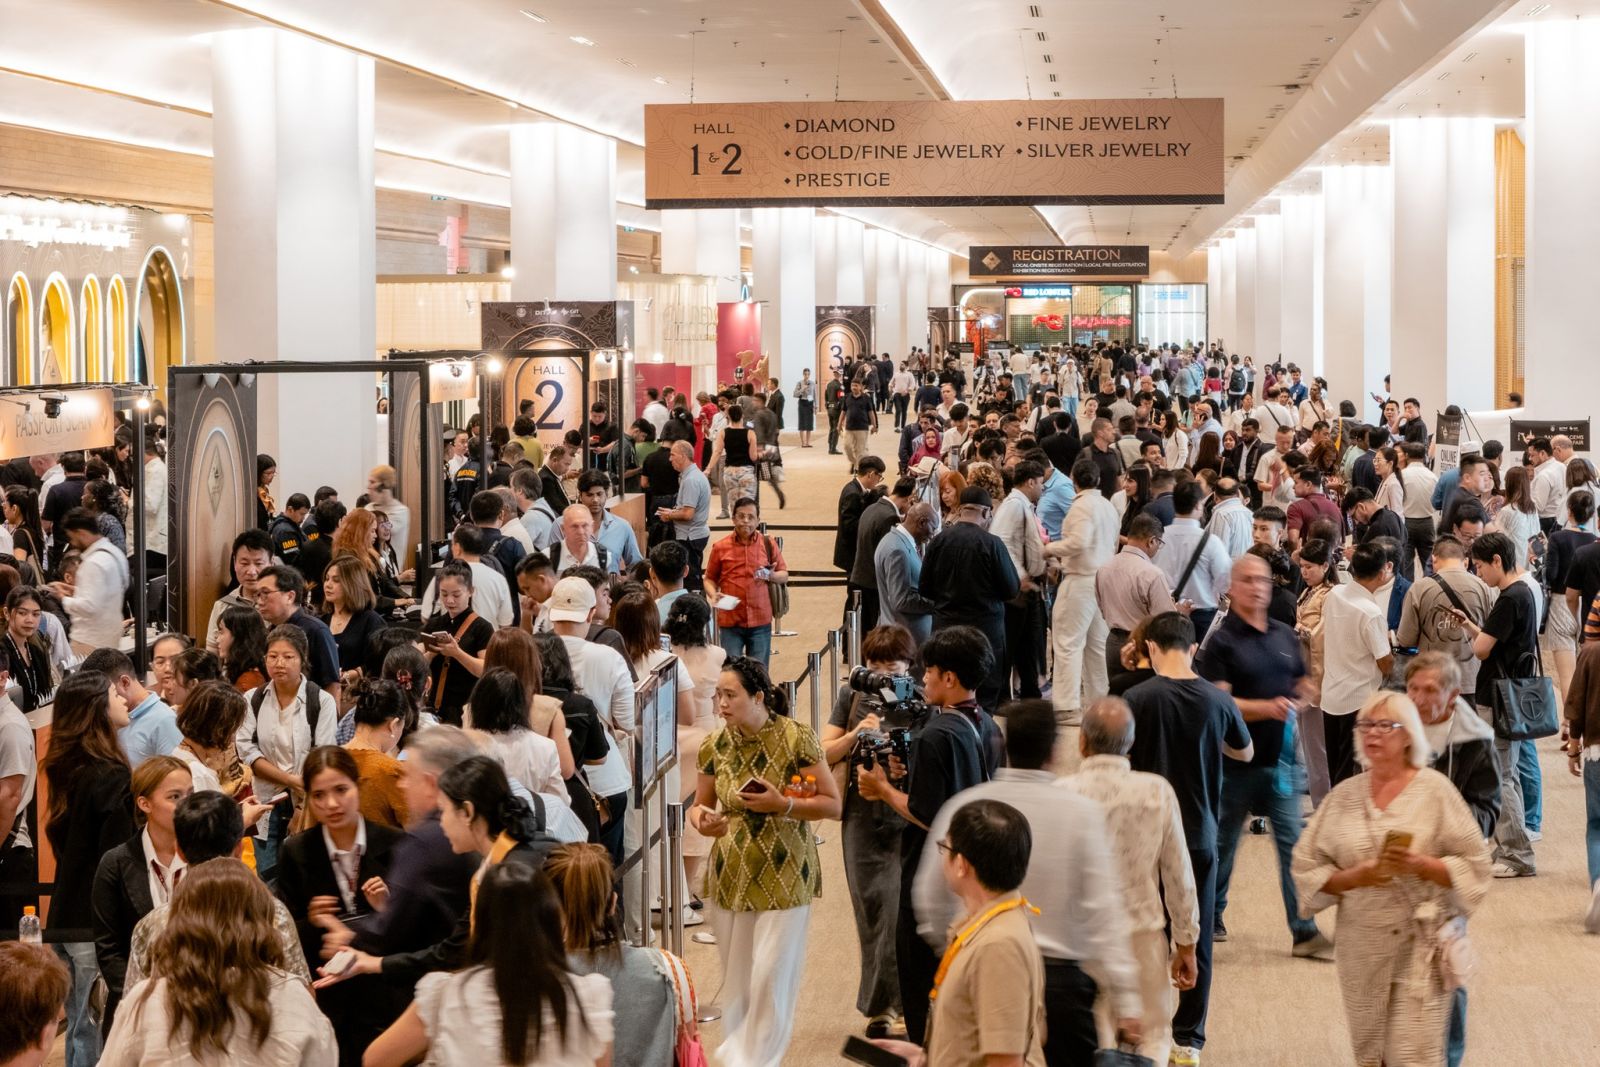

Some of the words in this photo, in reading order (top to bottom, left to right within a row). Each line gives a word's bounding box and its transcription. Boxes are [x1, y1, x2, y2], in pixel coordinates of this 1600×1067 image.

[693, 123, 735, 134] HALL
[795, 118, 895, 133] DIAMOND
[1027, 117, 1074, 131] FINE
[1078, 116, 1171, 131] JEWELRY
[795, 145, 908, 160] GOLD/FINE
[913, 144, 1005, 159] JEWELRY
[1027, 143, 1094, 158] SILVER
[1098, 142, 1191, 157] JEWELRY
[690, 143, 701, 176] 1
[721, 143, 743, 175] 2
[795, 172, 891, 187] PRESTIGE
[1012, 249, 1121, 261] REGISTRATION
[829, 345, 844, 371] 3
[533, 365, 565, 375] HALL
[534, 380, 565, 430] 2
[1440, 449, 1456, 464] ONLINE
